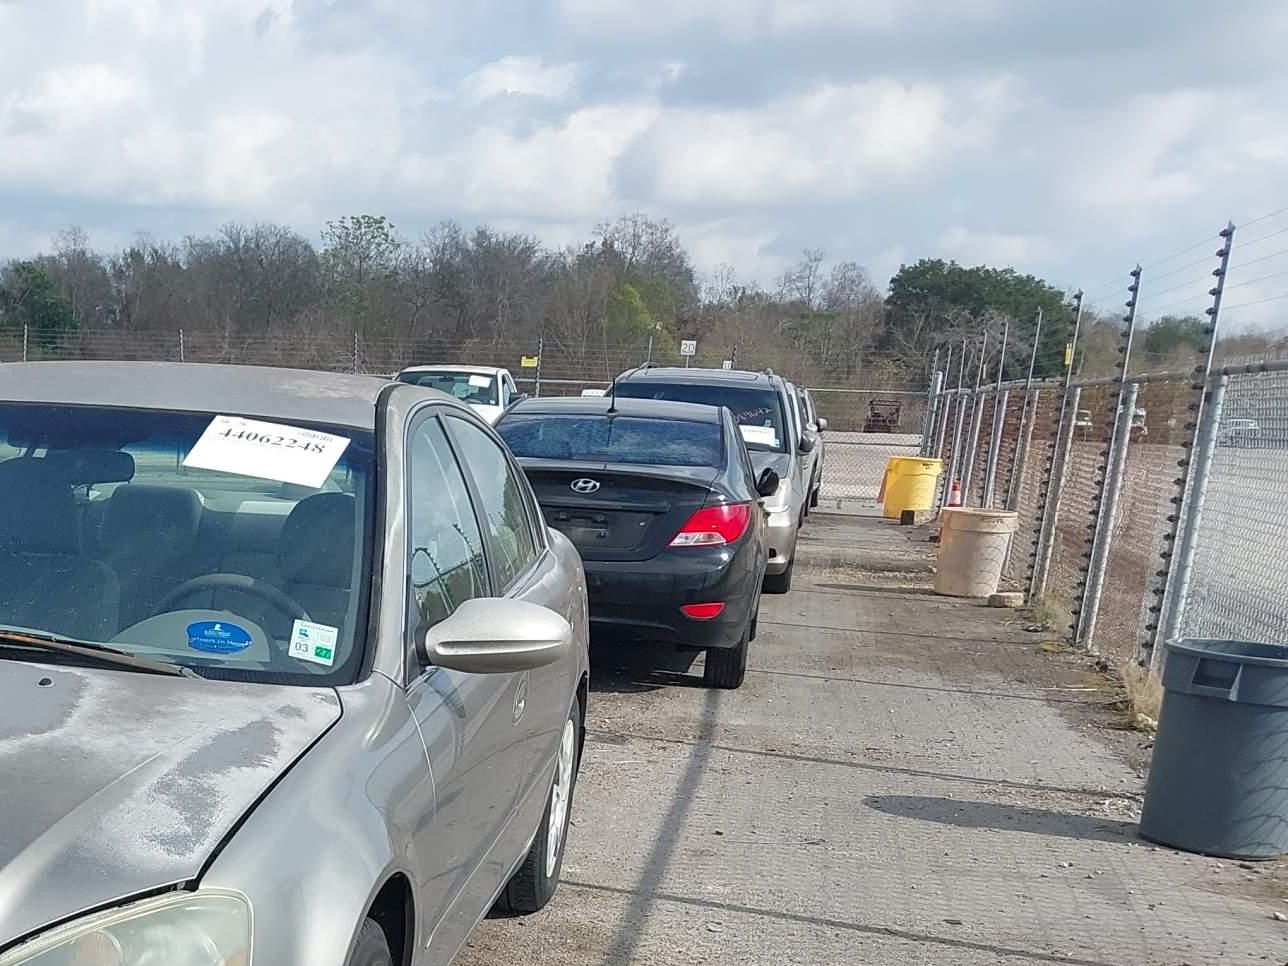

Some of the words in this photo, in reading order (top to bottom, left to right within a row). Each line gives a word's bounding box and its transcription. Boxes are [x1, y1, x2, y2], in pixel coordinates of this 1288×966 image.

[682, 343, 695, 353] 20
[219, 428, 325, 453] 44062248
[295, 641, 309, 653] 03
[316, 646, 331, 660] 27
